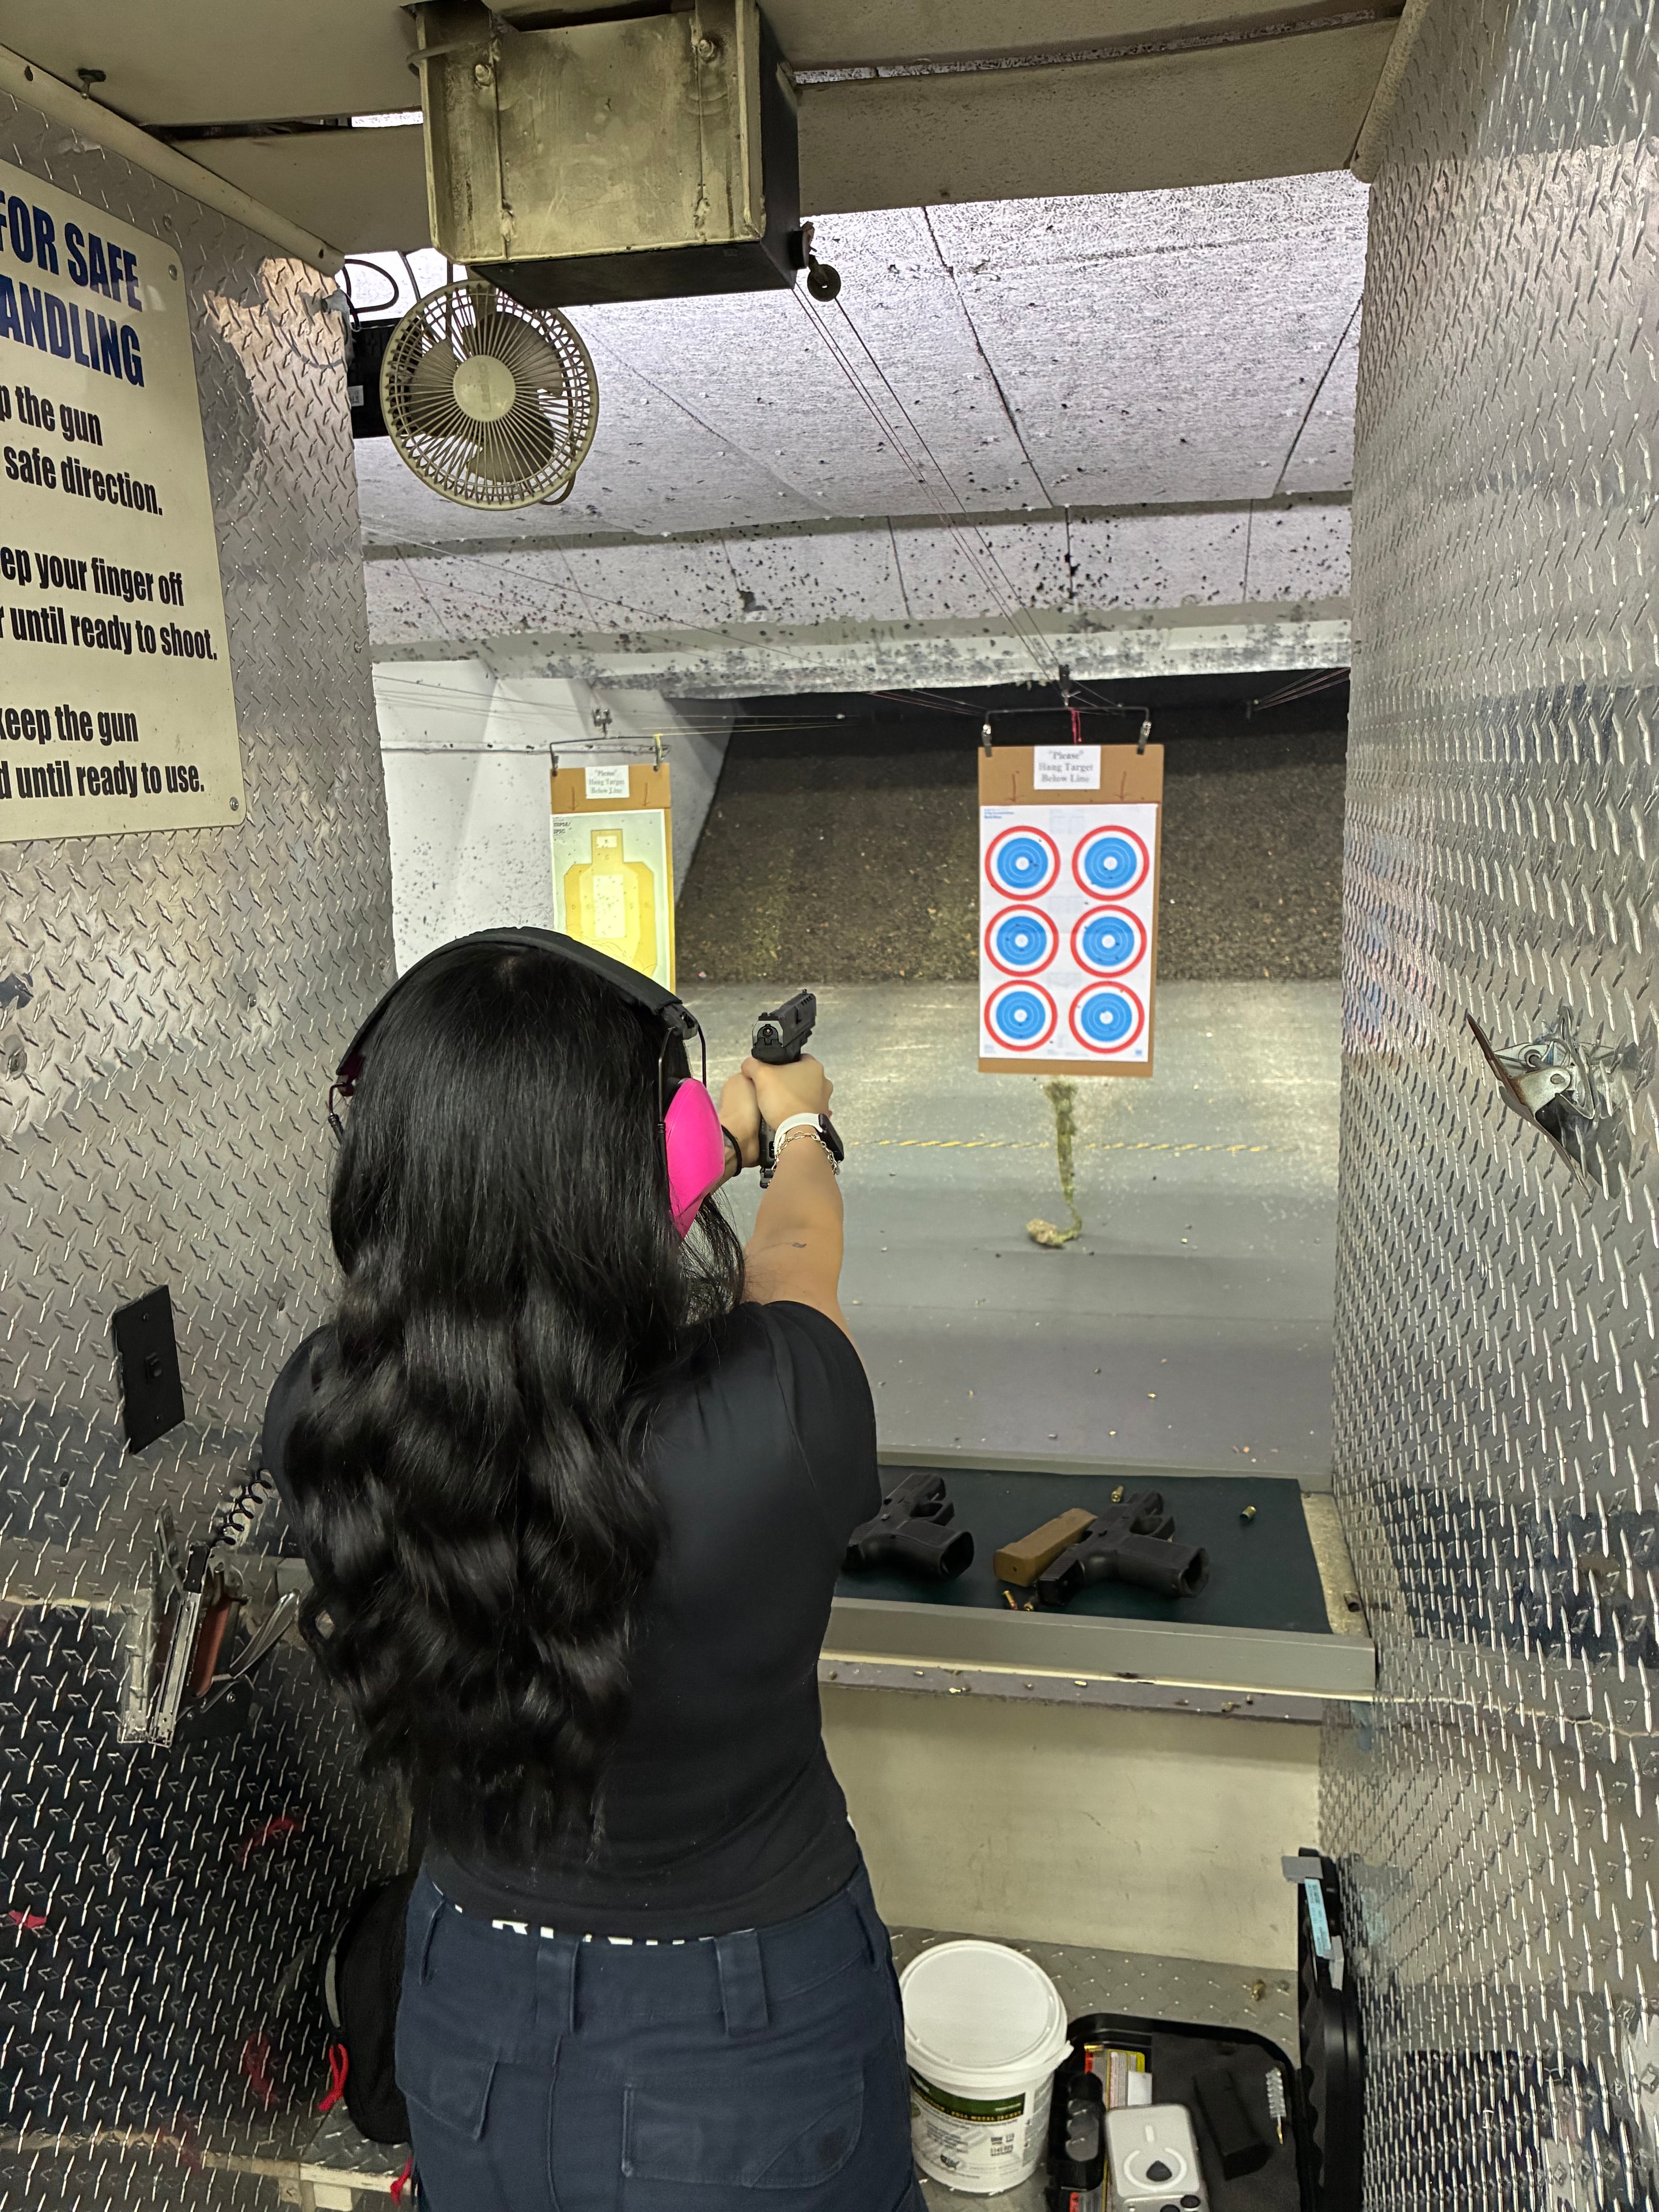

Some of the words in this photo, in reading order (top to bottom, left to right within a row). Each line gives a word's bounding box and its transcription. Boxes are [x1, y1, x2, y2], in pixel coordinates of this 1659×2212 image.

[65, 223, 142, 312] SAFE
[15, 386, 55, 431] the
[60, 404, 103, 446] gun
[4, 446, 56, 489] safe
[61, 456, 163, 516] direction.
[0, 547, 32, 586] ep
[35, 553, 87, 591] your
[92, 558, 153, 604] finger
[158, 572, 184, 606] off
[10, 607, 67, 645] until
[70, 615, 132, 654] ready
[135, 620, 157, 654] to
[160, 623, 218, 660] shoot.
[55, 704, 93, 741] the
[97, 712, 138, 746] gun
[16, 760, 73, 798] until
[76, 760, 137, 798] ready
[141, 763, 161, 793] to
[165, 765, 204, 793] use.
[1039, 763, 1062, 772] Hang
[1065, 763, 1093, 772] Target
[1041, 774, 1067, 782] Below
[1070, 774, 1090, 782] Line
